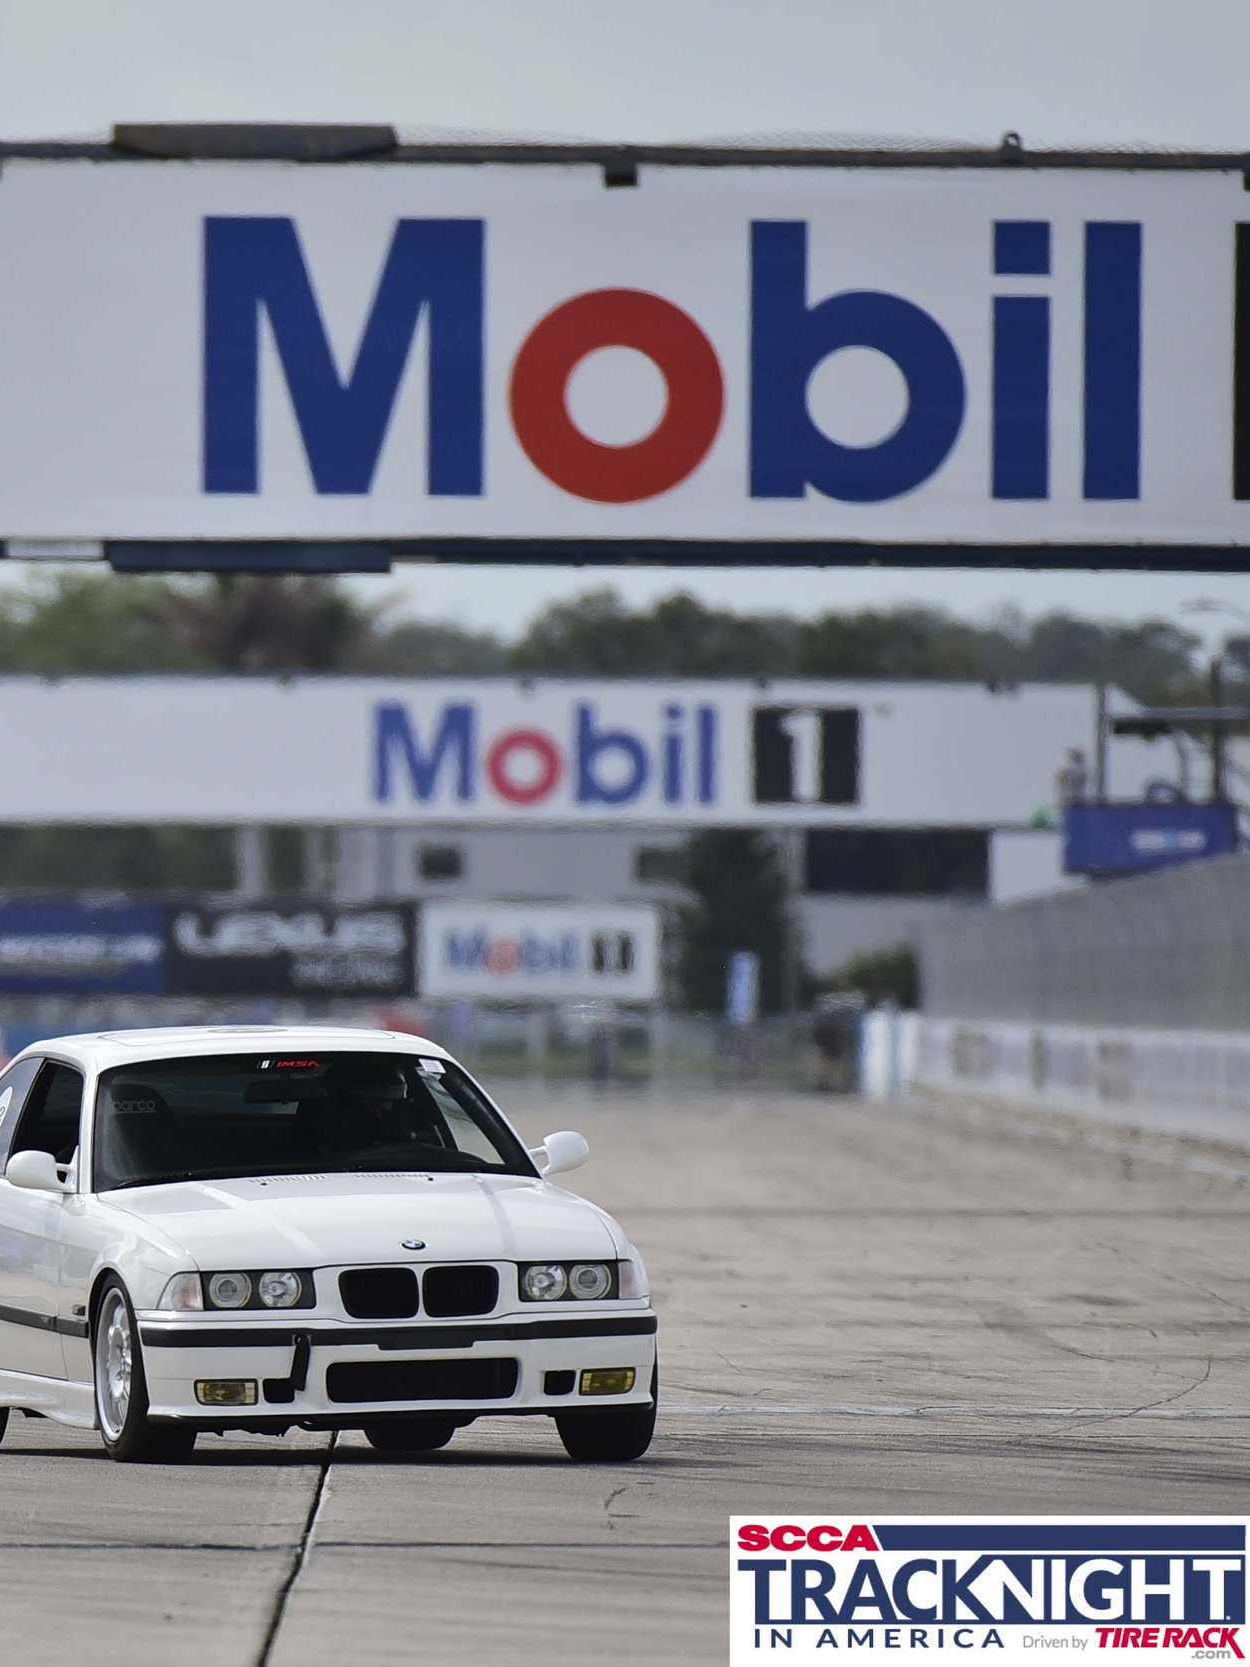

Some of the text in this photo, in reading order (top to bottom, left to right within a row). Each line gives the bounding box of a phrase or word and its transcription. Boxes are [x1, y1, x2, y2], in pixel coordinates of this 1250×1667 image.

[203, 216, 1142, 503] Mobil
[374, 702, 823, 807] Mobil 1
